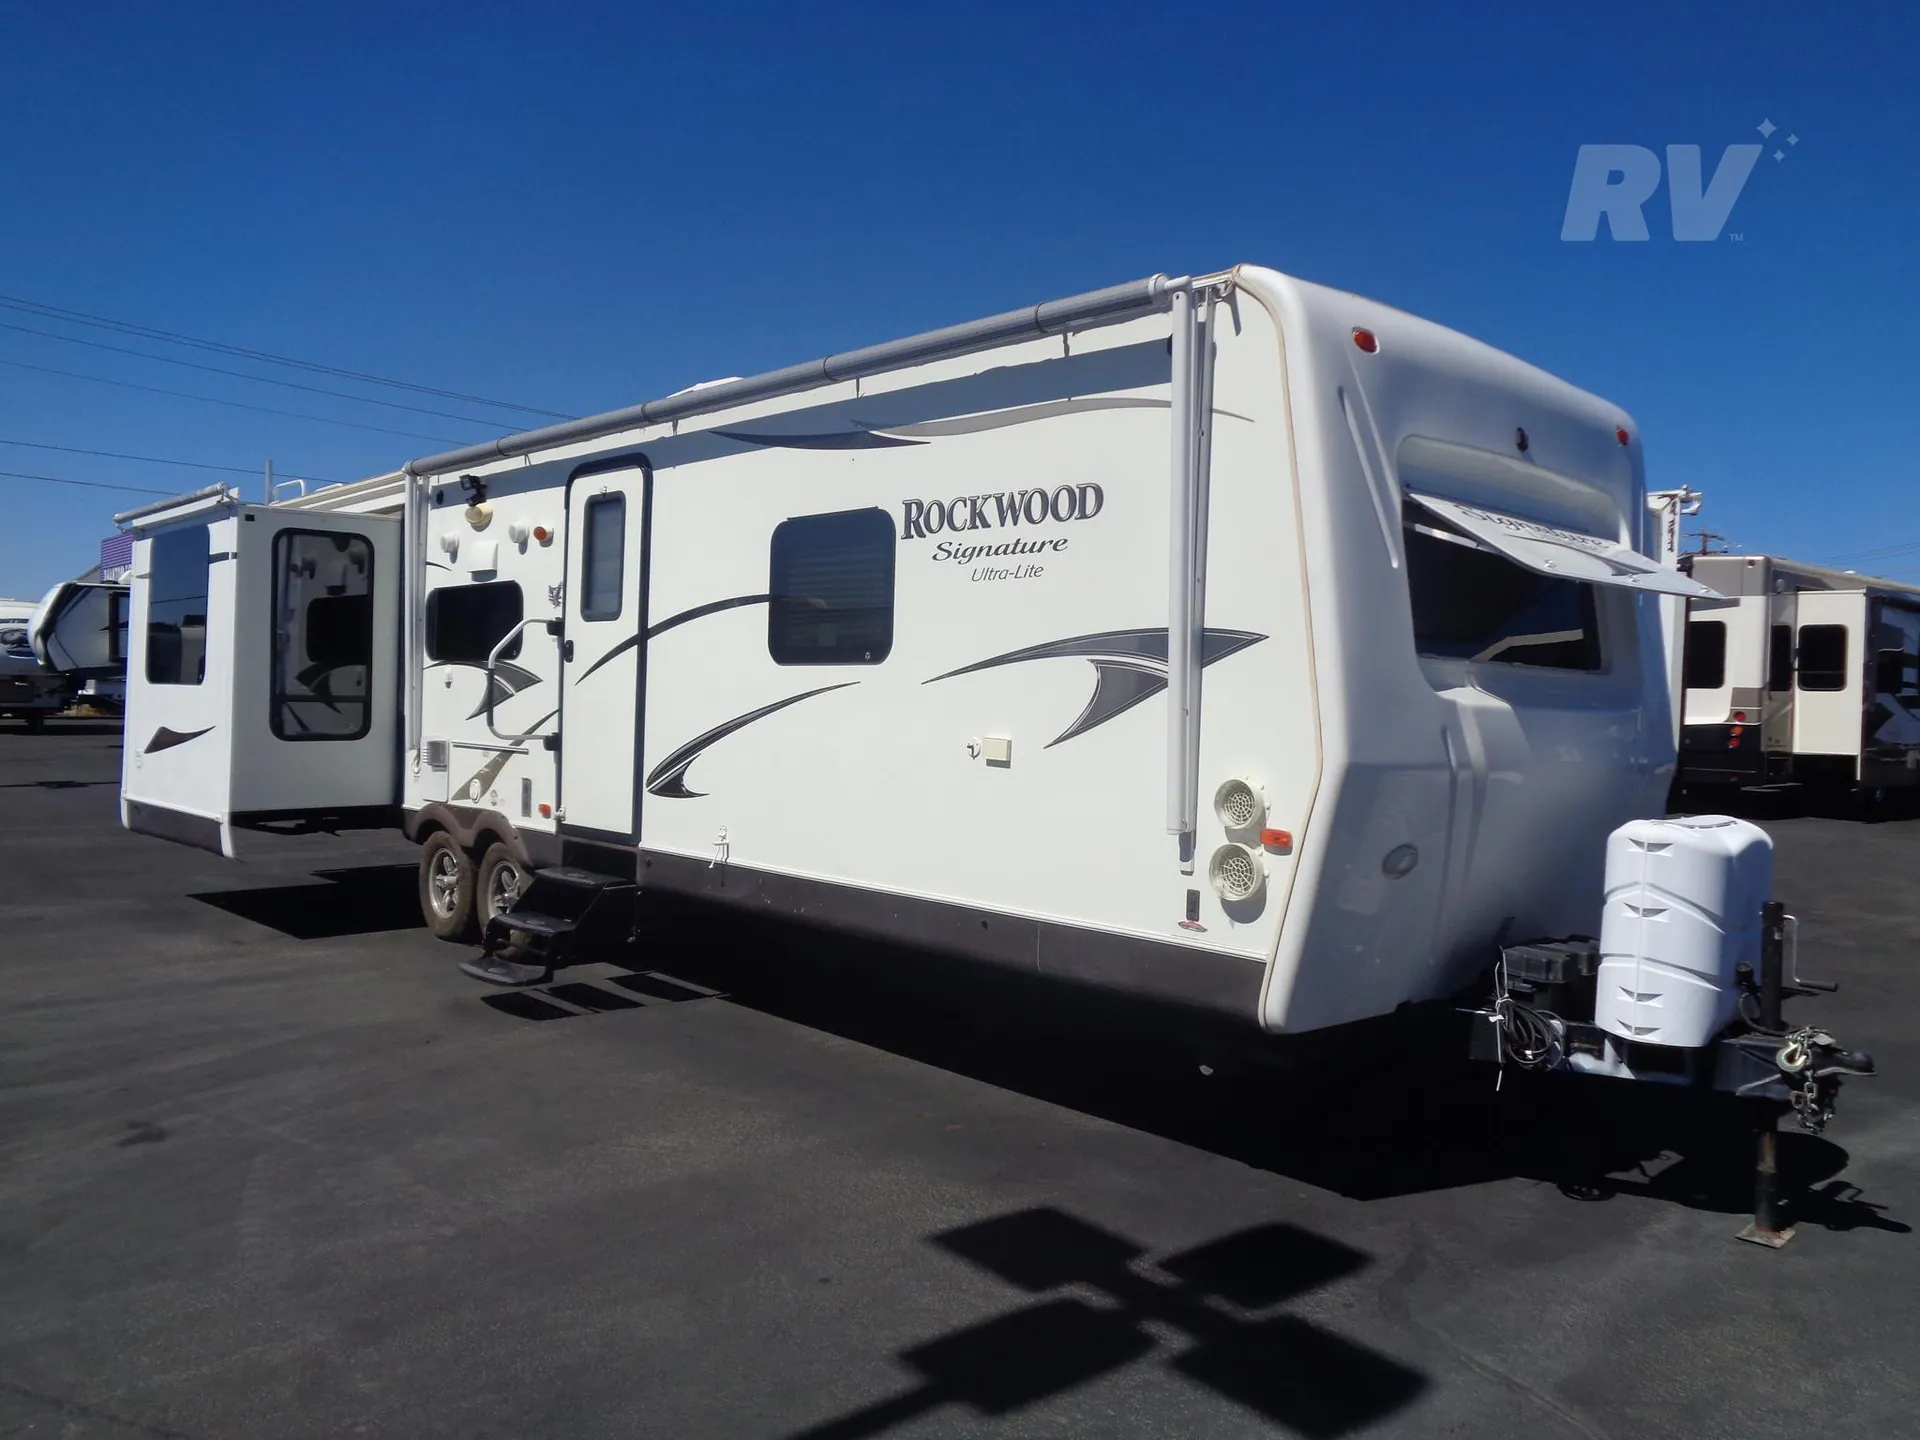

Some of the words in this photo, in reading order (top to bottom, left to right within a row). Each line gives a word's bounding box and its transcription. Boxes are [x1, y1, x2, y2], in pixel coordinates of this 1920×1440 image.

[900, 482, 1104, 540] ROCKWOOD
[932, 538, 1068, 565] Signature
[971, 563, 1044, 582] Ultra-Lite
